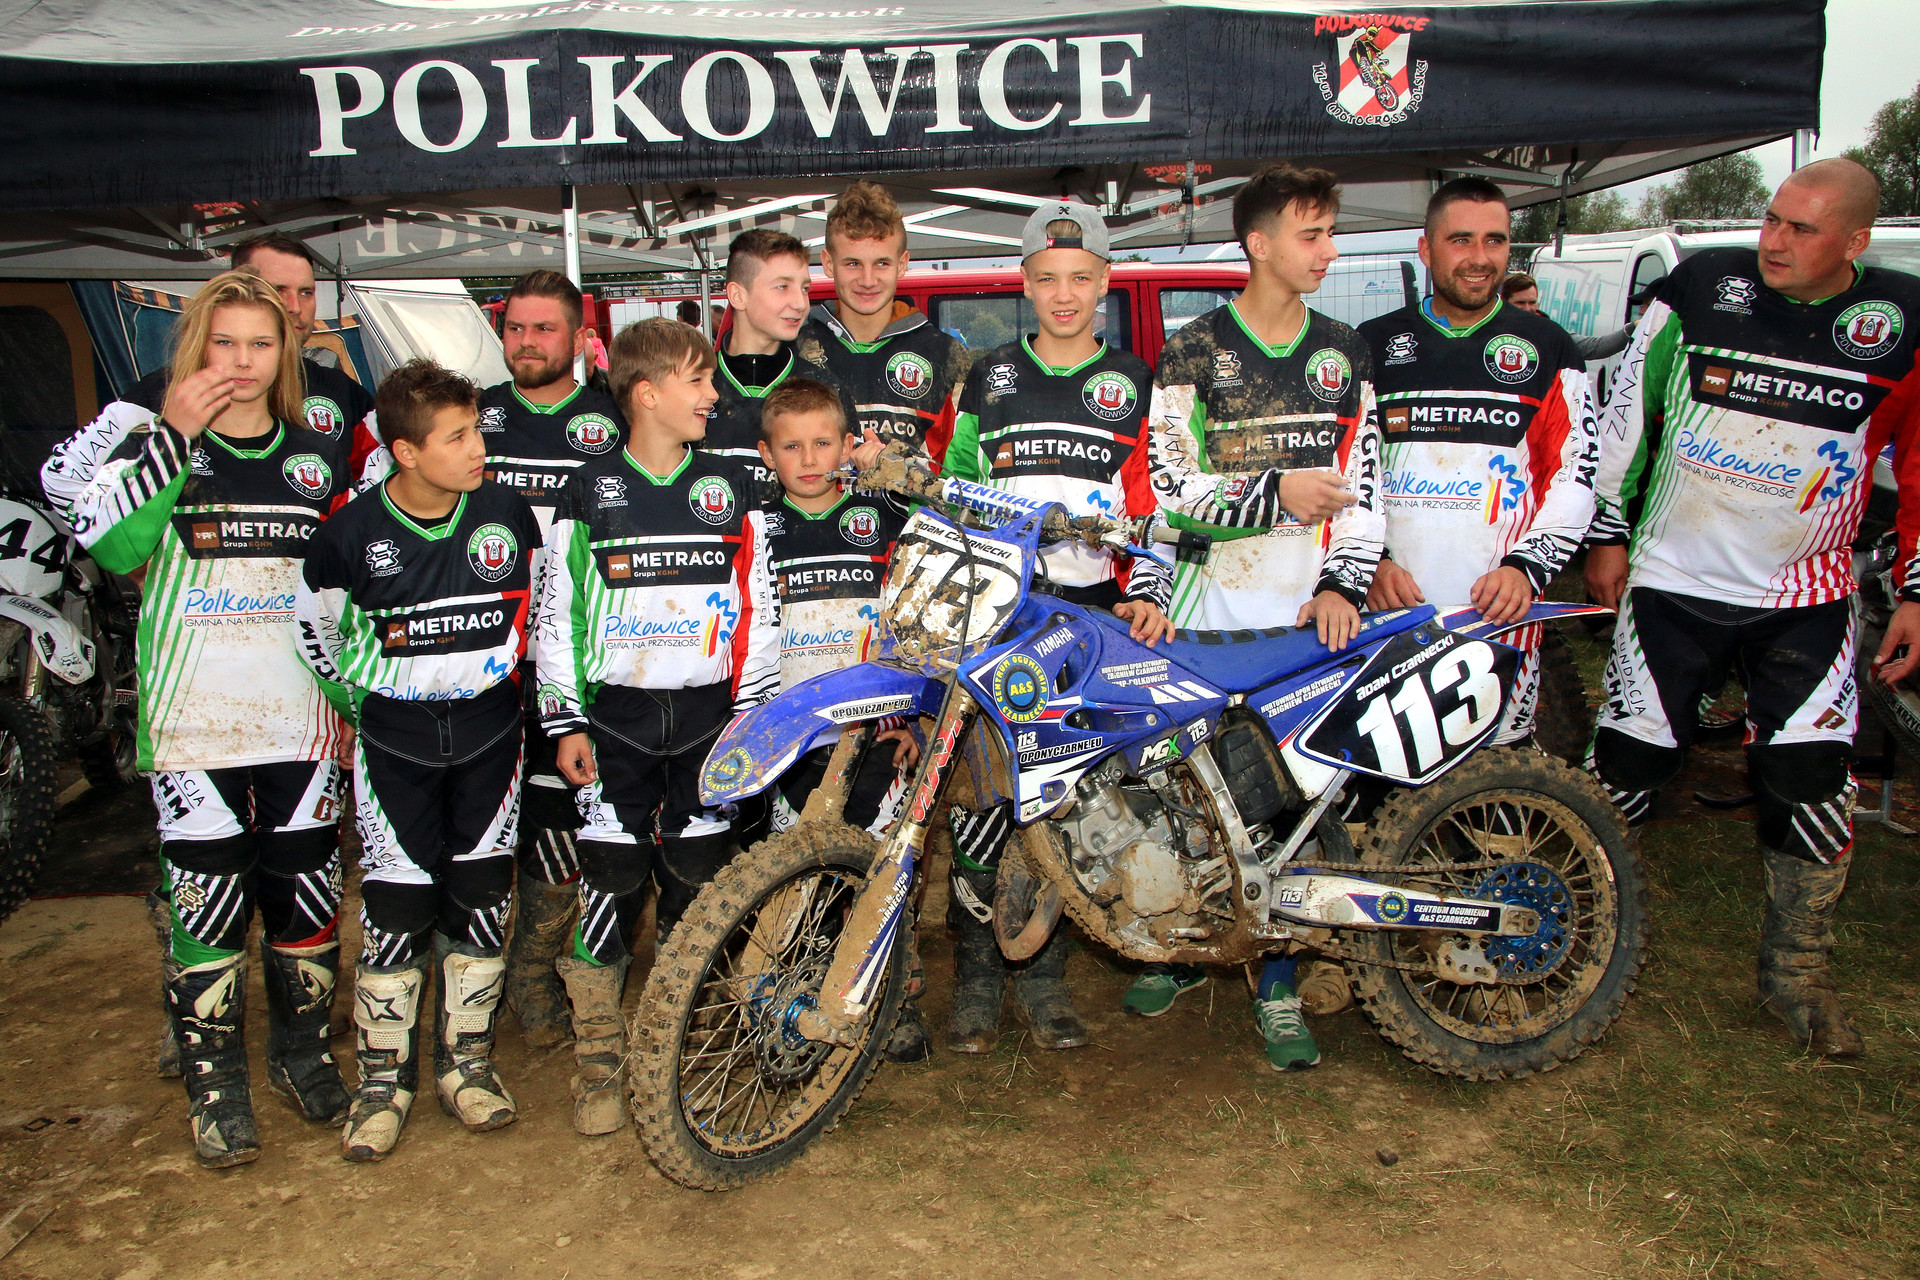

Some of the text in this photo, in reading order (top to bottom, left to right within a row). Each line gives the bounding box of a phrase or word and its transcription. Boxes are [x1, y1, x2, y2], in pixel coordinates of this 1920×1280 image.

[688, 7, 906, 19] Hodowli
[1314, 14, 1431, 36] POLKOWICE
[300, 33, 1151, 157] POLKOWICE
[1837, 333, 1892, 357] POLKOWICE
[1488, 362, 1533, 382] POLKOWICE
[1729, 391, 1789, 408] Grupa KGHM
[1731, 370, 1864, 410] METRACO
[1087, 398, 1131, 418] POLKOWICE
[1411, 406, 1520, 427] METRACO
[1014, 439, 1112, 464] METRACO
[1677, 430, 1802, 483] Polkowice
[1015, 458, 1037, 466] Grupa
[1381, 471, 1482, 496] Polkowice
[1676, 457, 1796, 500] GMINA NA PRZYSZŁOŚĆ
[695, 505, 733, 523] POLKOWICE
[1404, 499, 1481, 510] NA PRZYSZŁOŚĆ
[474, 559, 514, 579] POLKOWICE
[632, 551, 726, 568] METRACO
[788, 568, 874, 587] METRACO
[184, 586, 296, 614] Polkowice
[789, 587, 809, 595] Grupa
[185, 618, 223, 627] GMINA
[226, 617, 243, 626] NA
[409, 609, 503, 636] METRACO
[605, 612, 701, 638] Polkowice
[1382, 608, 1412, 622] YAMAHA
[409, 638, 435, 646] Grupa
[632, 641, 646, 649] NA
[648, 637, 701, 648] PRZYSZŁOŚĆ
[794, 650, 806, 658] NA
[808, 646, 855, 656] PRZYSZŁOŚĆ
[1033, 626, 1075, 658] YAMAHA
[994, 655, 1048, 703] CENTRUM OGUMIENIA
[1135, 664, 1168, 676] CZARNECKI
[1619, 632, 1646, 716] FUNDACJA
[1010, 681, 1034, 697] A&S
[1260, 670, 1346, 714] HURTOWNIA OPON UŻYWANYCH
[1267, 678, 1343, 719] ZBIGNIEW CZARNECKI
[1002, 697, 1047, 722] CZARNECCY
[1355, 640, 1501, 779] 113
[1017, 731, 1037, 749] 113
[1190, 721, 1208, 743] 113
[1020, 736, 1103, 763] OPONYCZARNE.EU
[1139, 733, 1181, 767] MGX
[1281, 888, 1303, 903] 113
[1385, 902, 1401, 911] A&S
[1413, 904, 1490, 918] CENTRUM OGUMIENIA
[1418, 913, 1479, 925] A&S CZARNECCY
